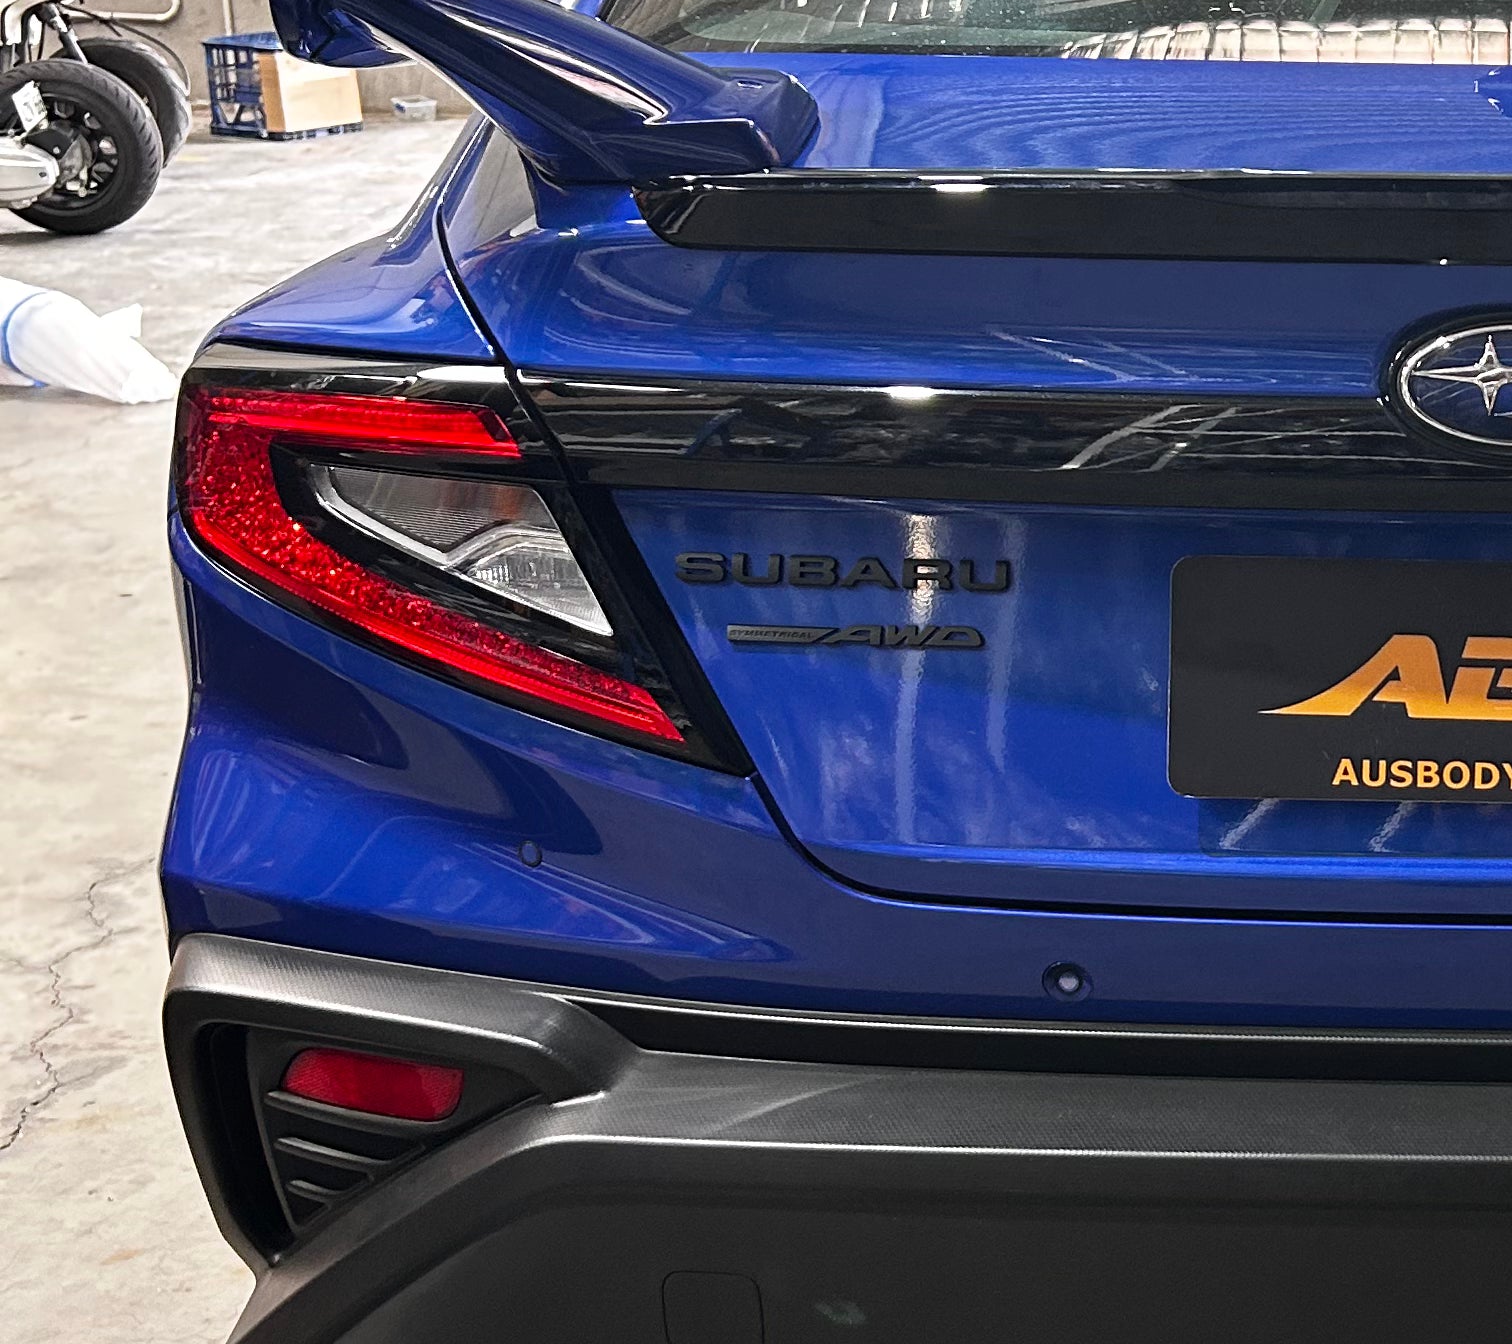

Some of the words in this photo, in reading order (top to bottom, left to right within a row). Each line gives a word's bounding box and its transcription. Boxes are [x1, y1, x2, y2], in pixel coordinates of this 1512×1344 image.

[675, 552, 1011, 592] SUBARU
[729, 629, 814, 639] SYMMETRICAL
[821, 625, 985, 649] AWD
